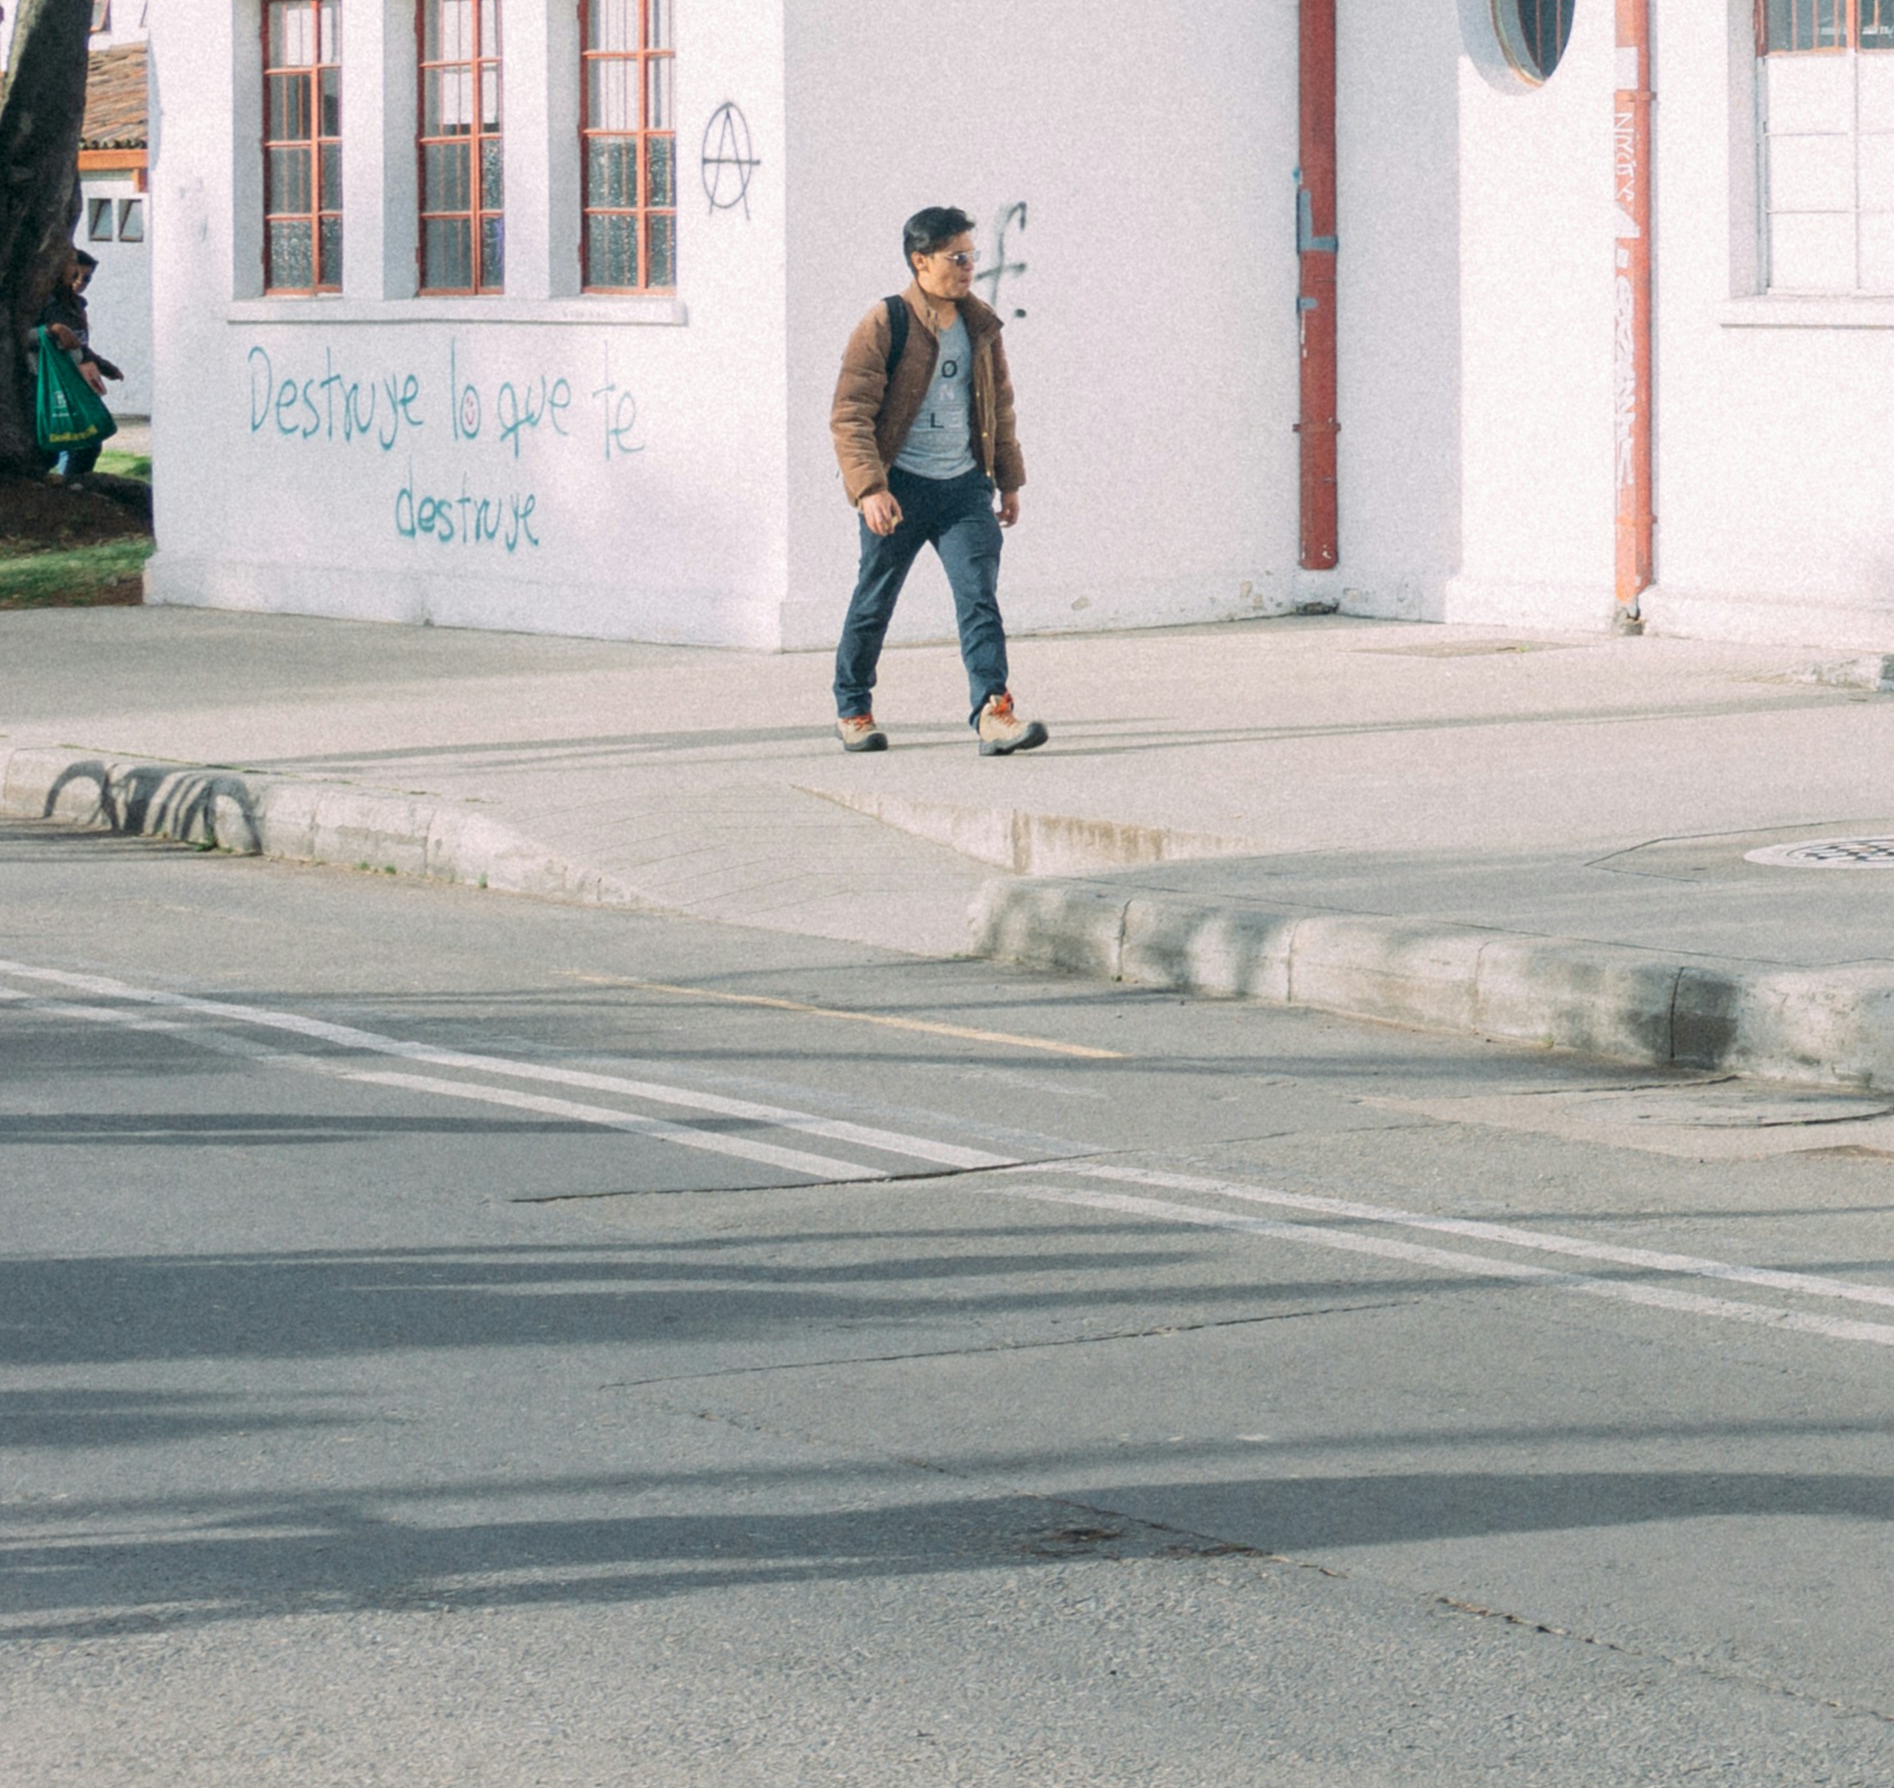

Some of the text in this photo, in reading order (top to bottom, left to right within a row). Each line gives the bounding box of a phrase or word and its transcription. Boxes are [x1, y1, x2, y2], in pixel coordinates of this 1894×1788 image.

[248, 346, 423, 451] Destruye
[450, 337, 482, 440] lo
[499, 374, 572, 458] que
[395, 454, 540, 552] destruye
